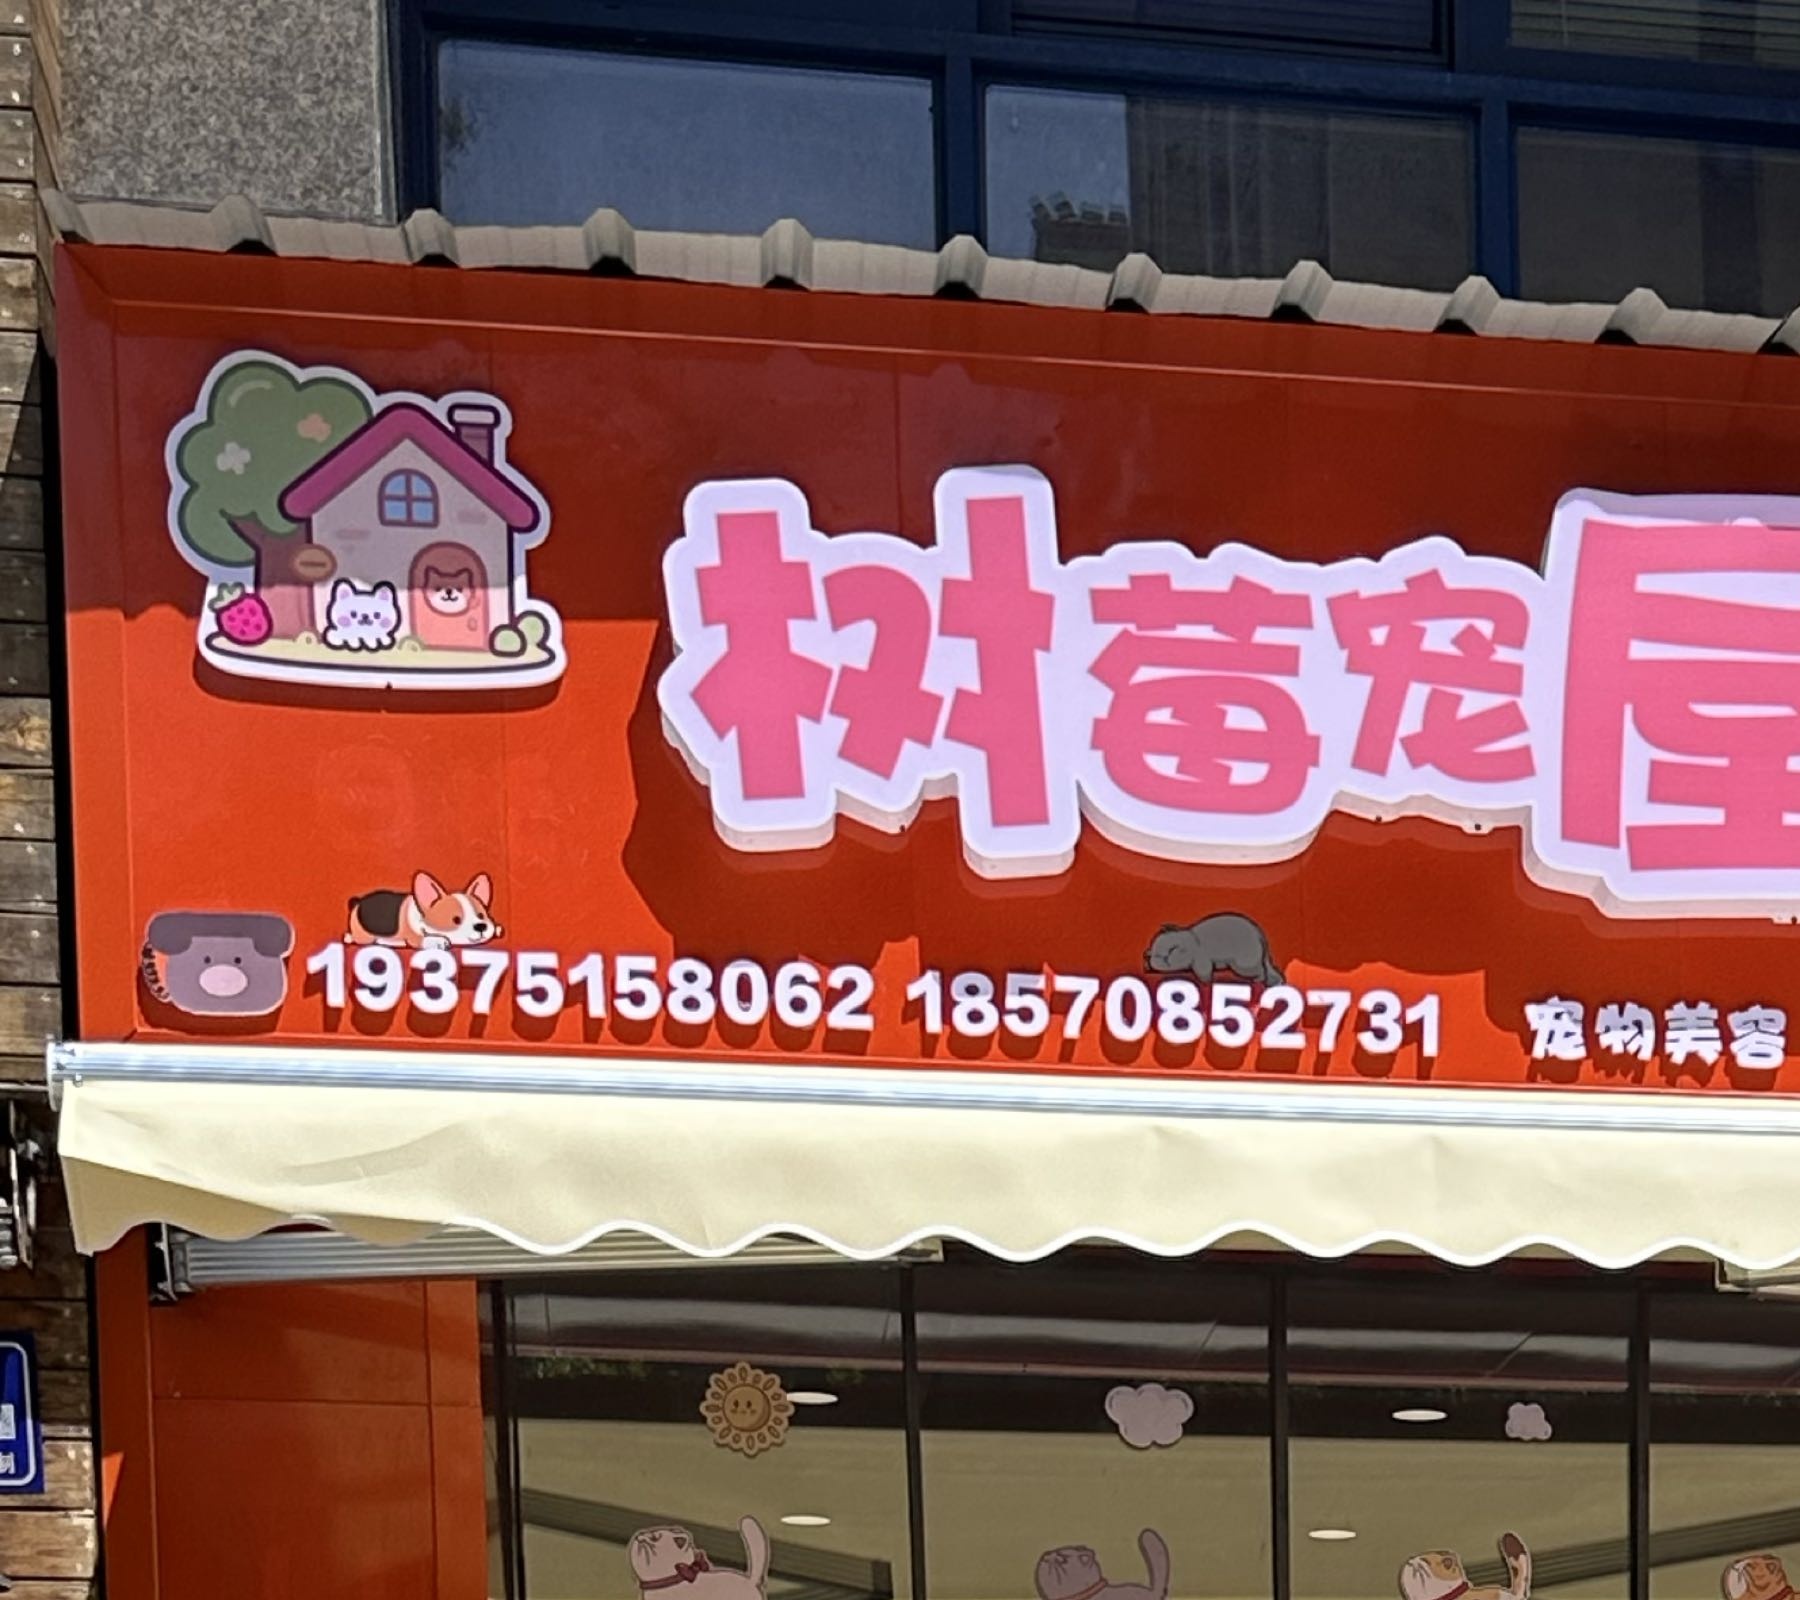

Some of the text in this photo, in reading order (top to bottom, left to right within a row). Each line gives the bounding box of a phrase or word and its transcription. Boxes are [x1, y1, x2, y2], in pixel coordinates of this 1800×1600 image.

[305, 941, 877, 1032] 19375158062
[905, 970, 1444, 1062] 18570852731
[1526, 996, 1787, 1069] 宠物美容
